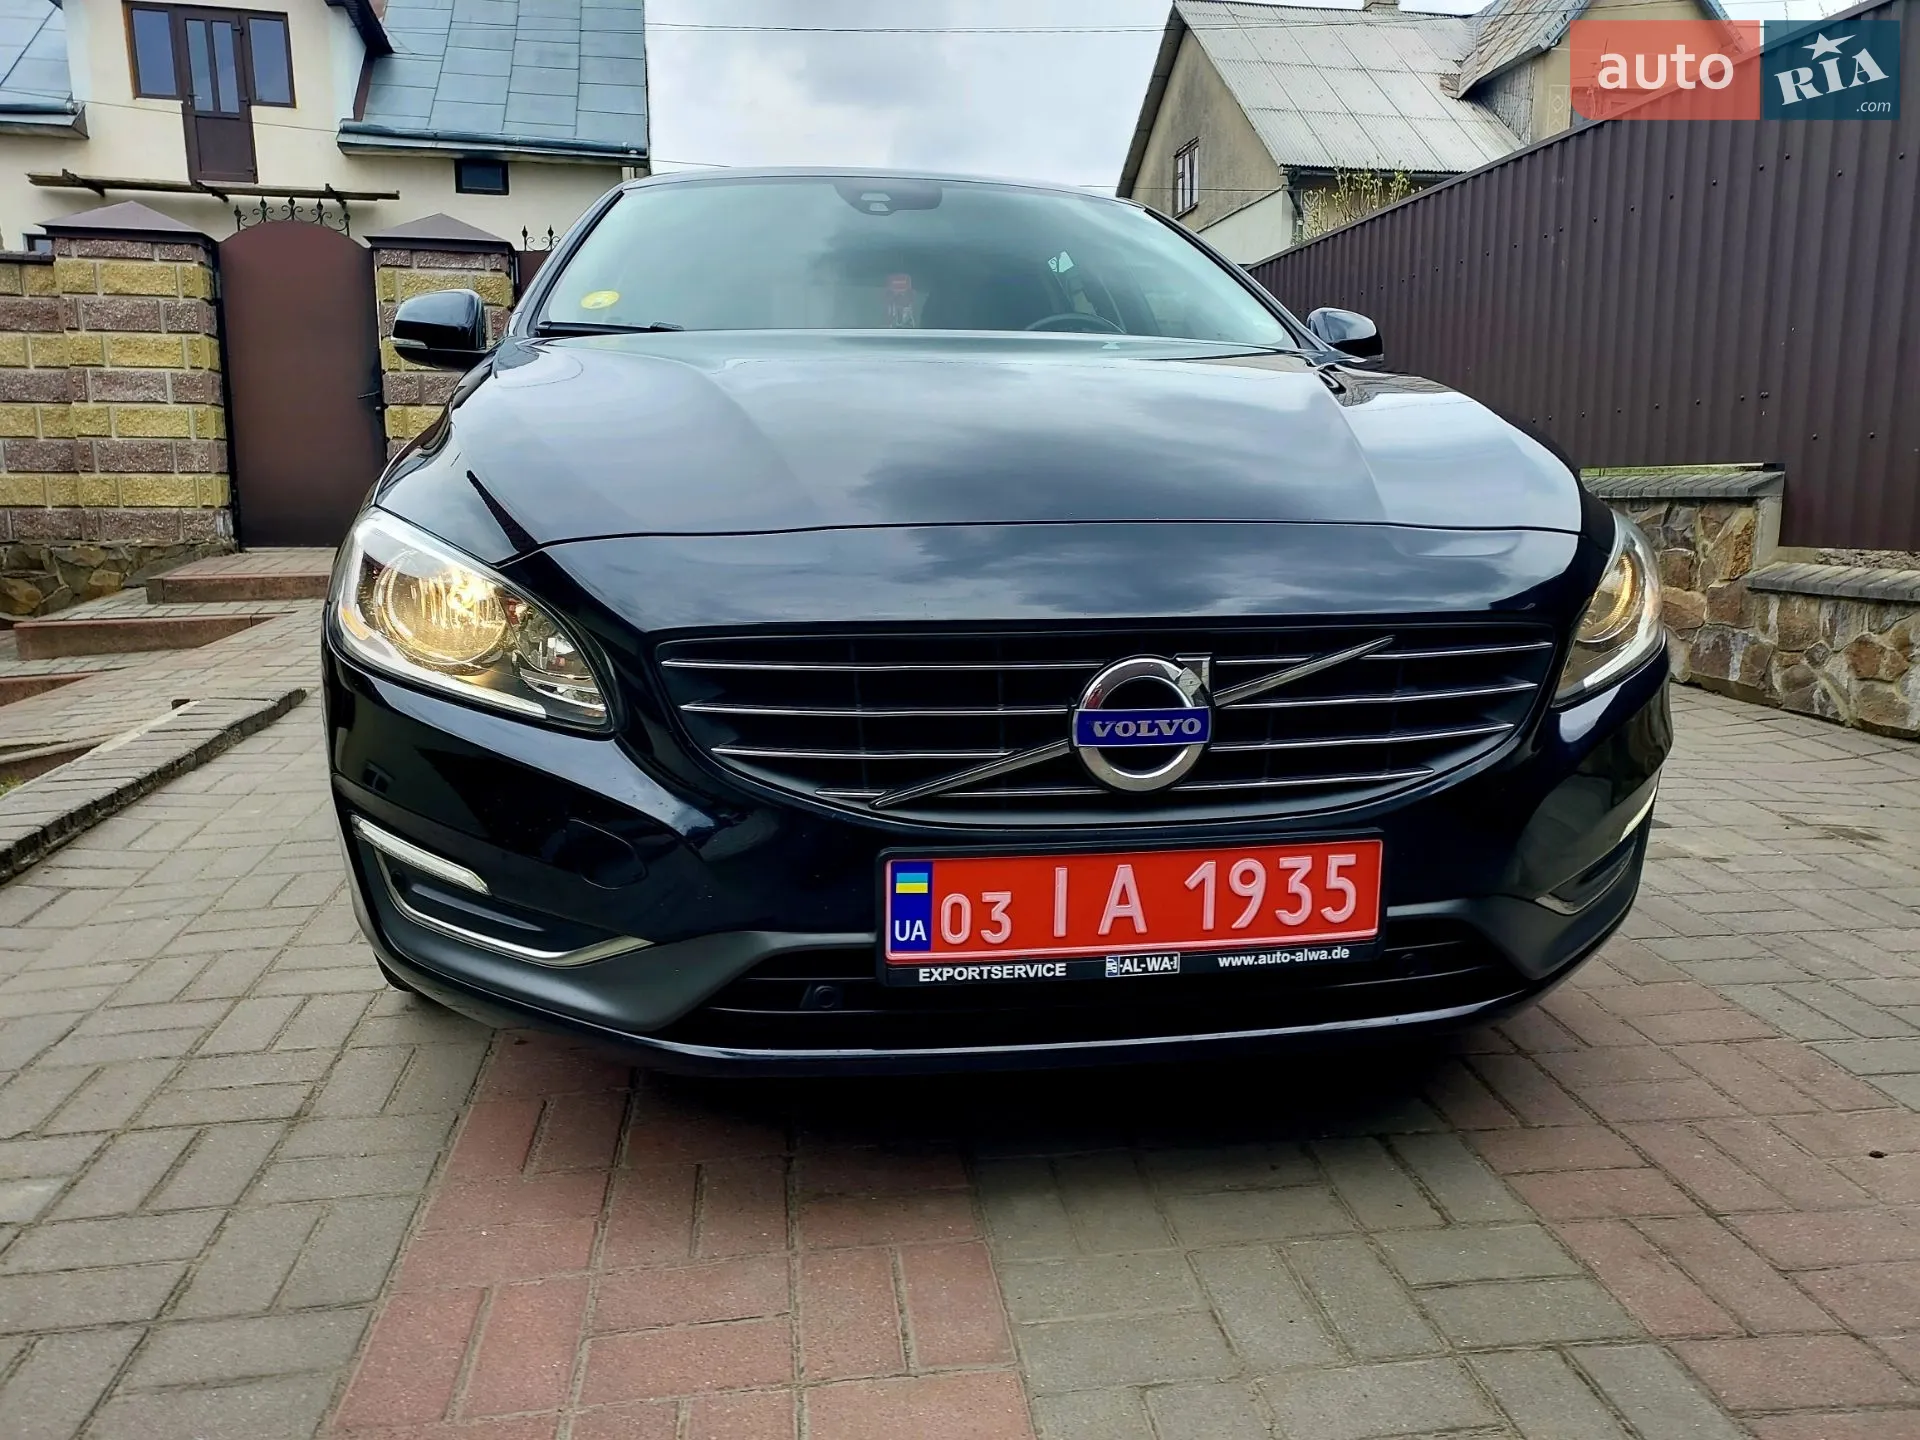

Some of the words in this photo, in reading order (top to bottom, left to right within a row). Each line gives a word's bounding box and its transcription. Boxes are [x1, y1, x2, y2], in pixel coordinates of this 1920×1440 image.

[1088, 717, 1202, 737] VOLVO
[940, 891, 1012, 945] 03
[1184, 853, 1357, 931] 1935
[894, 919, 927, 941] UA
[1217, 946, 1350, 967] www.auto-alwa.de
[918, 962, 1067, 982] EXPORTSERVICE
